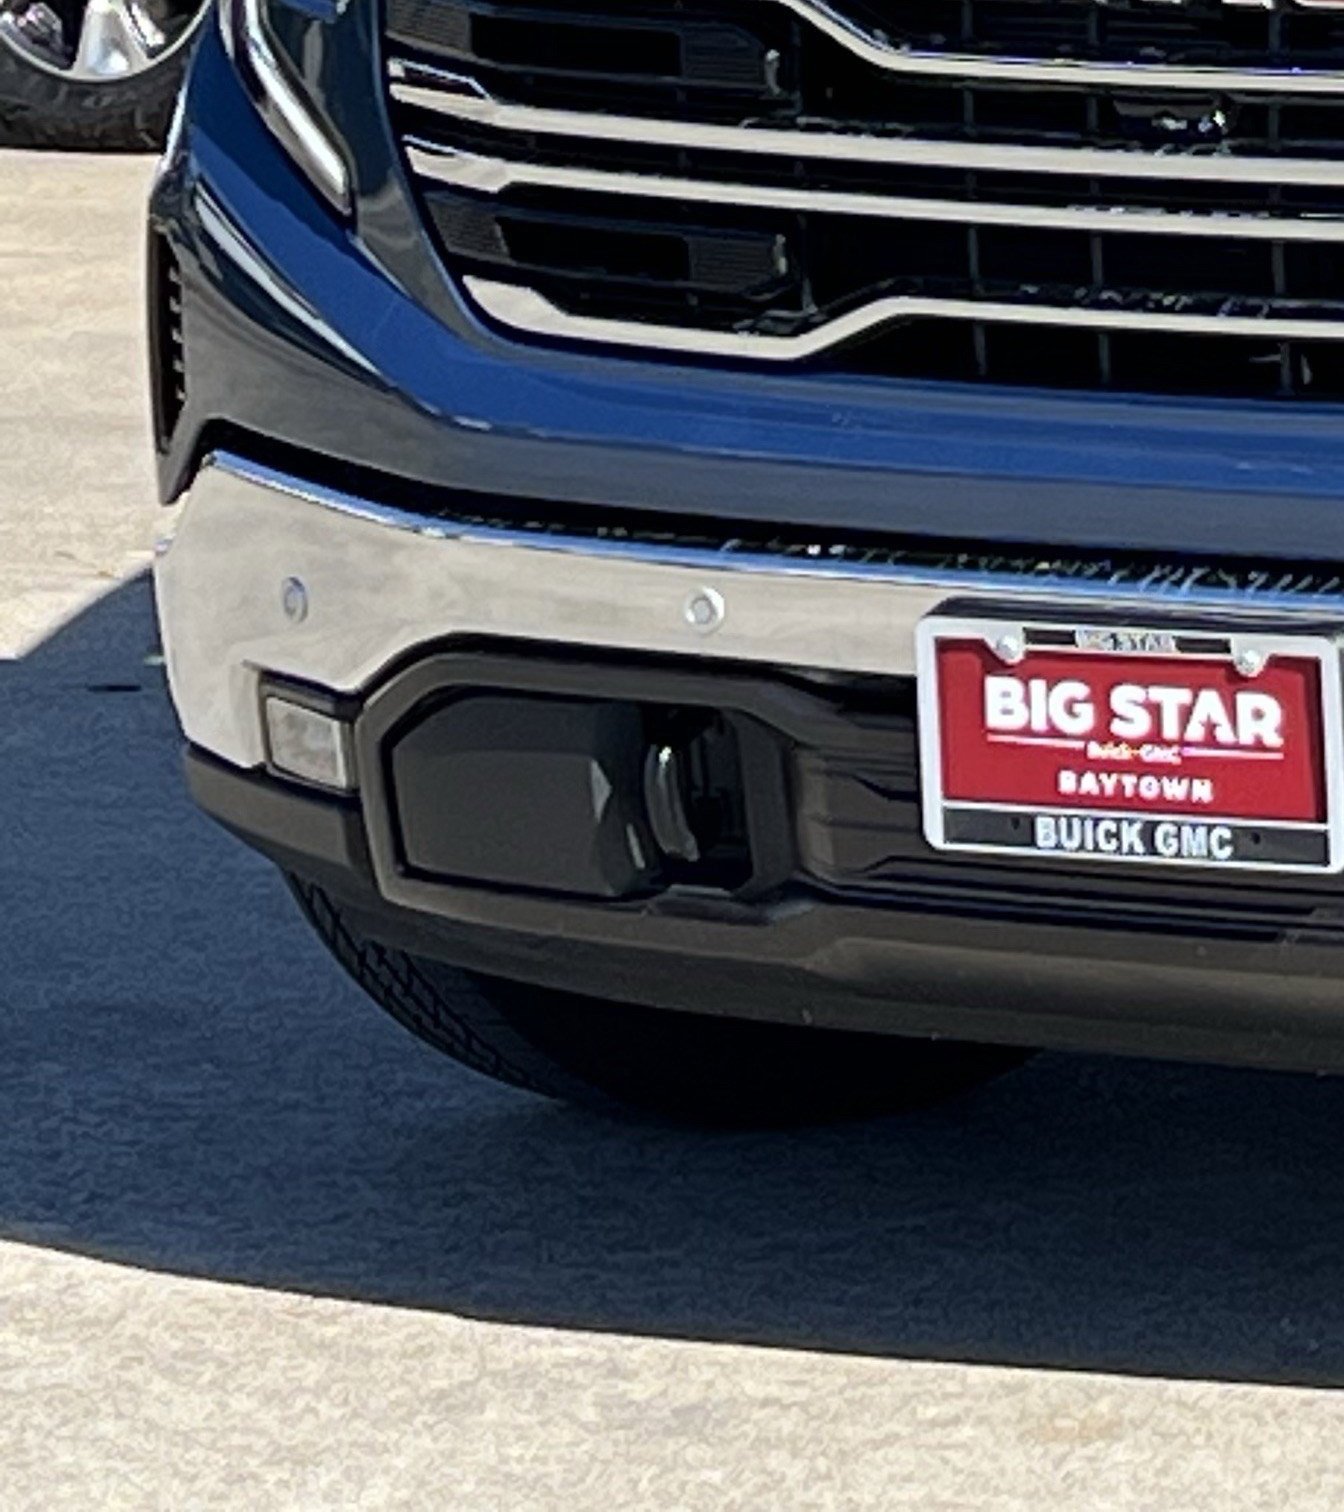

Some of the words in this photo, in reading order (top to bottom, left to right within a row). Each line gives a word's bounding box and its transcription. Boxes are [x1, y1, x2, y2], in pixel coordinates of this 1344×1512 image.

[984, 675, 1095, 735] BIG
[1110, 684, 1285, 748] STAR
[1057, 770, 1214, 804] BAYTOWN
[1034, 816, 1146, 855] BUICK
[1154, 824, 1235, 861] GMC
